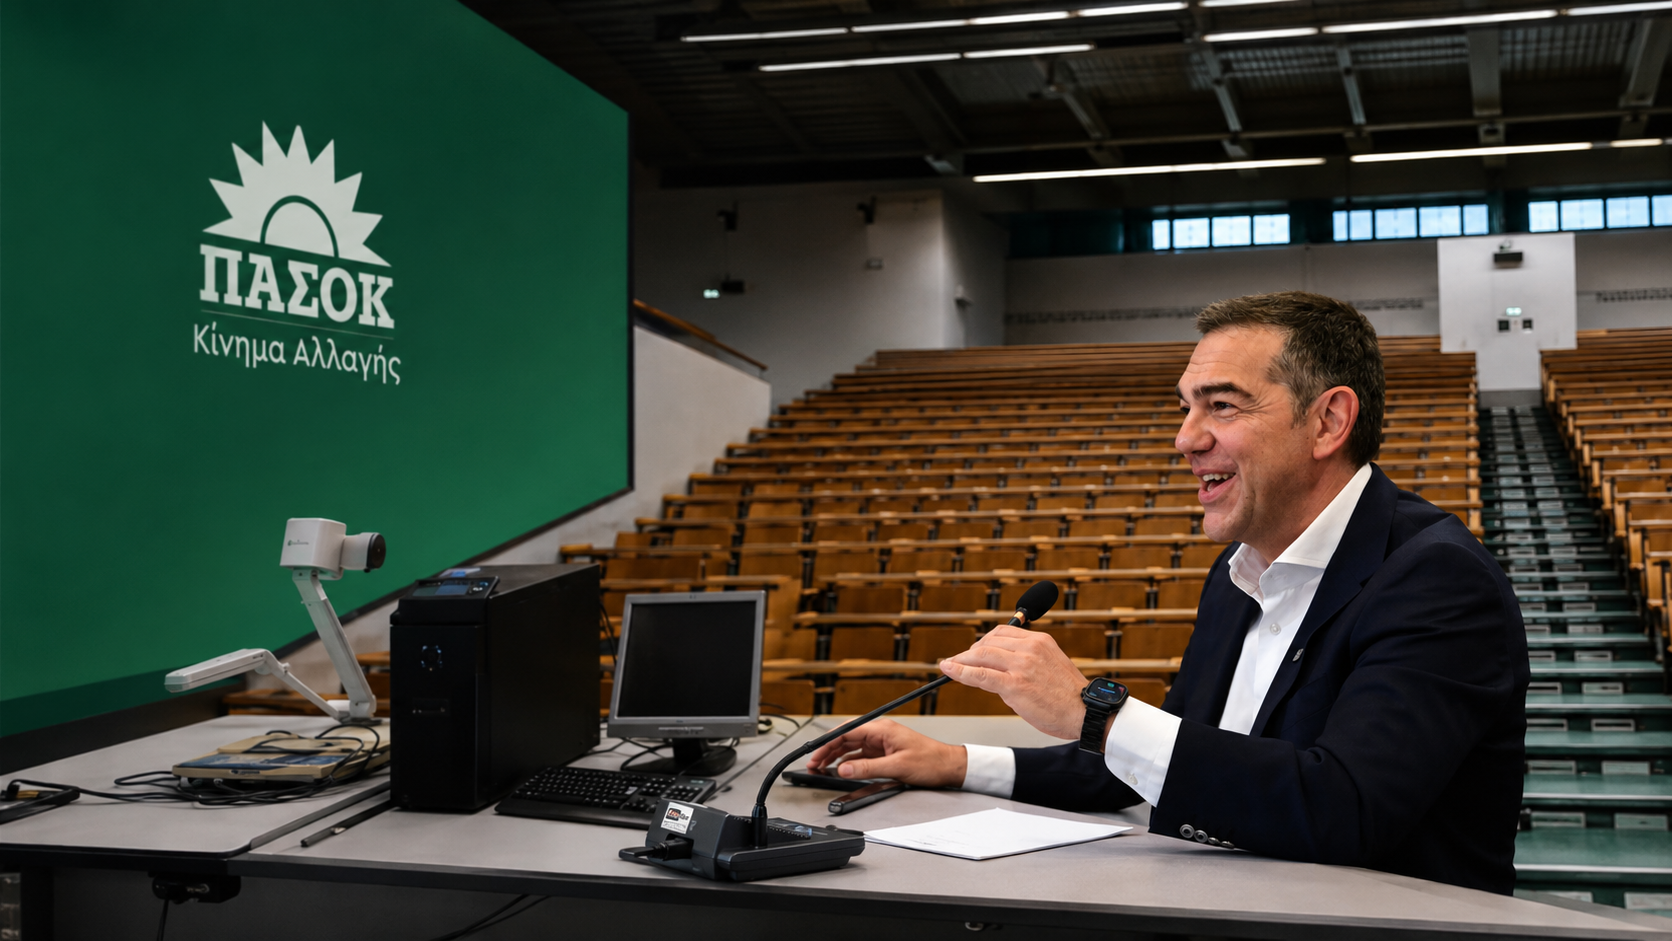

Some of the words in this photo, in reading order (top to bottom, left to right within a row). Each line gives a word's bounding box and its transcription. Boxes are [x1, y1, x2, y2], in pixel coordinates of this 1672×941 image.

[200, 244, 395, 329] ΠΑΣΟΚ
[194, 321, 286, 369] Κίνημα
[293, 335, 401, 386] Αλλαγής
